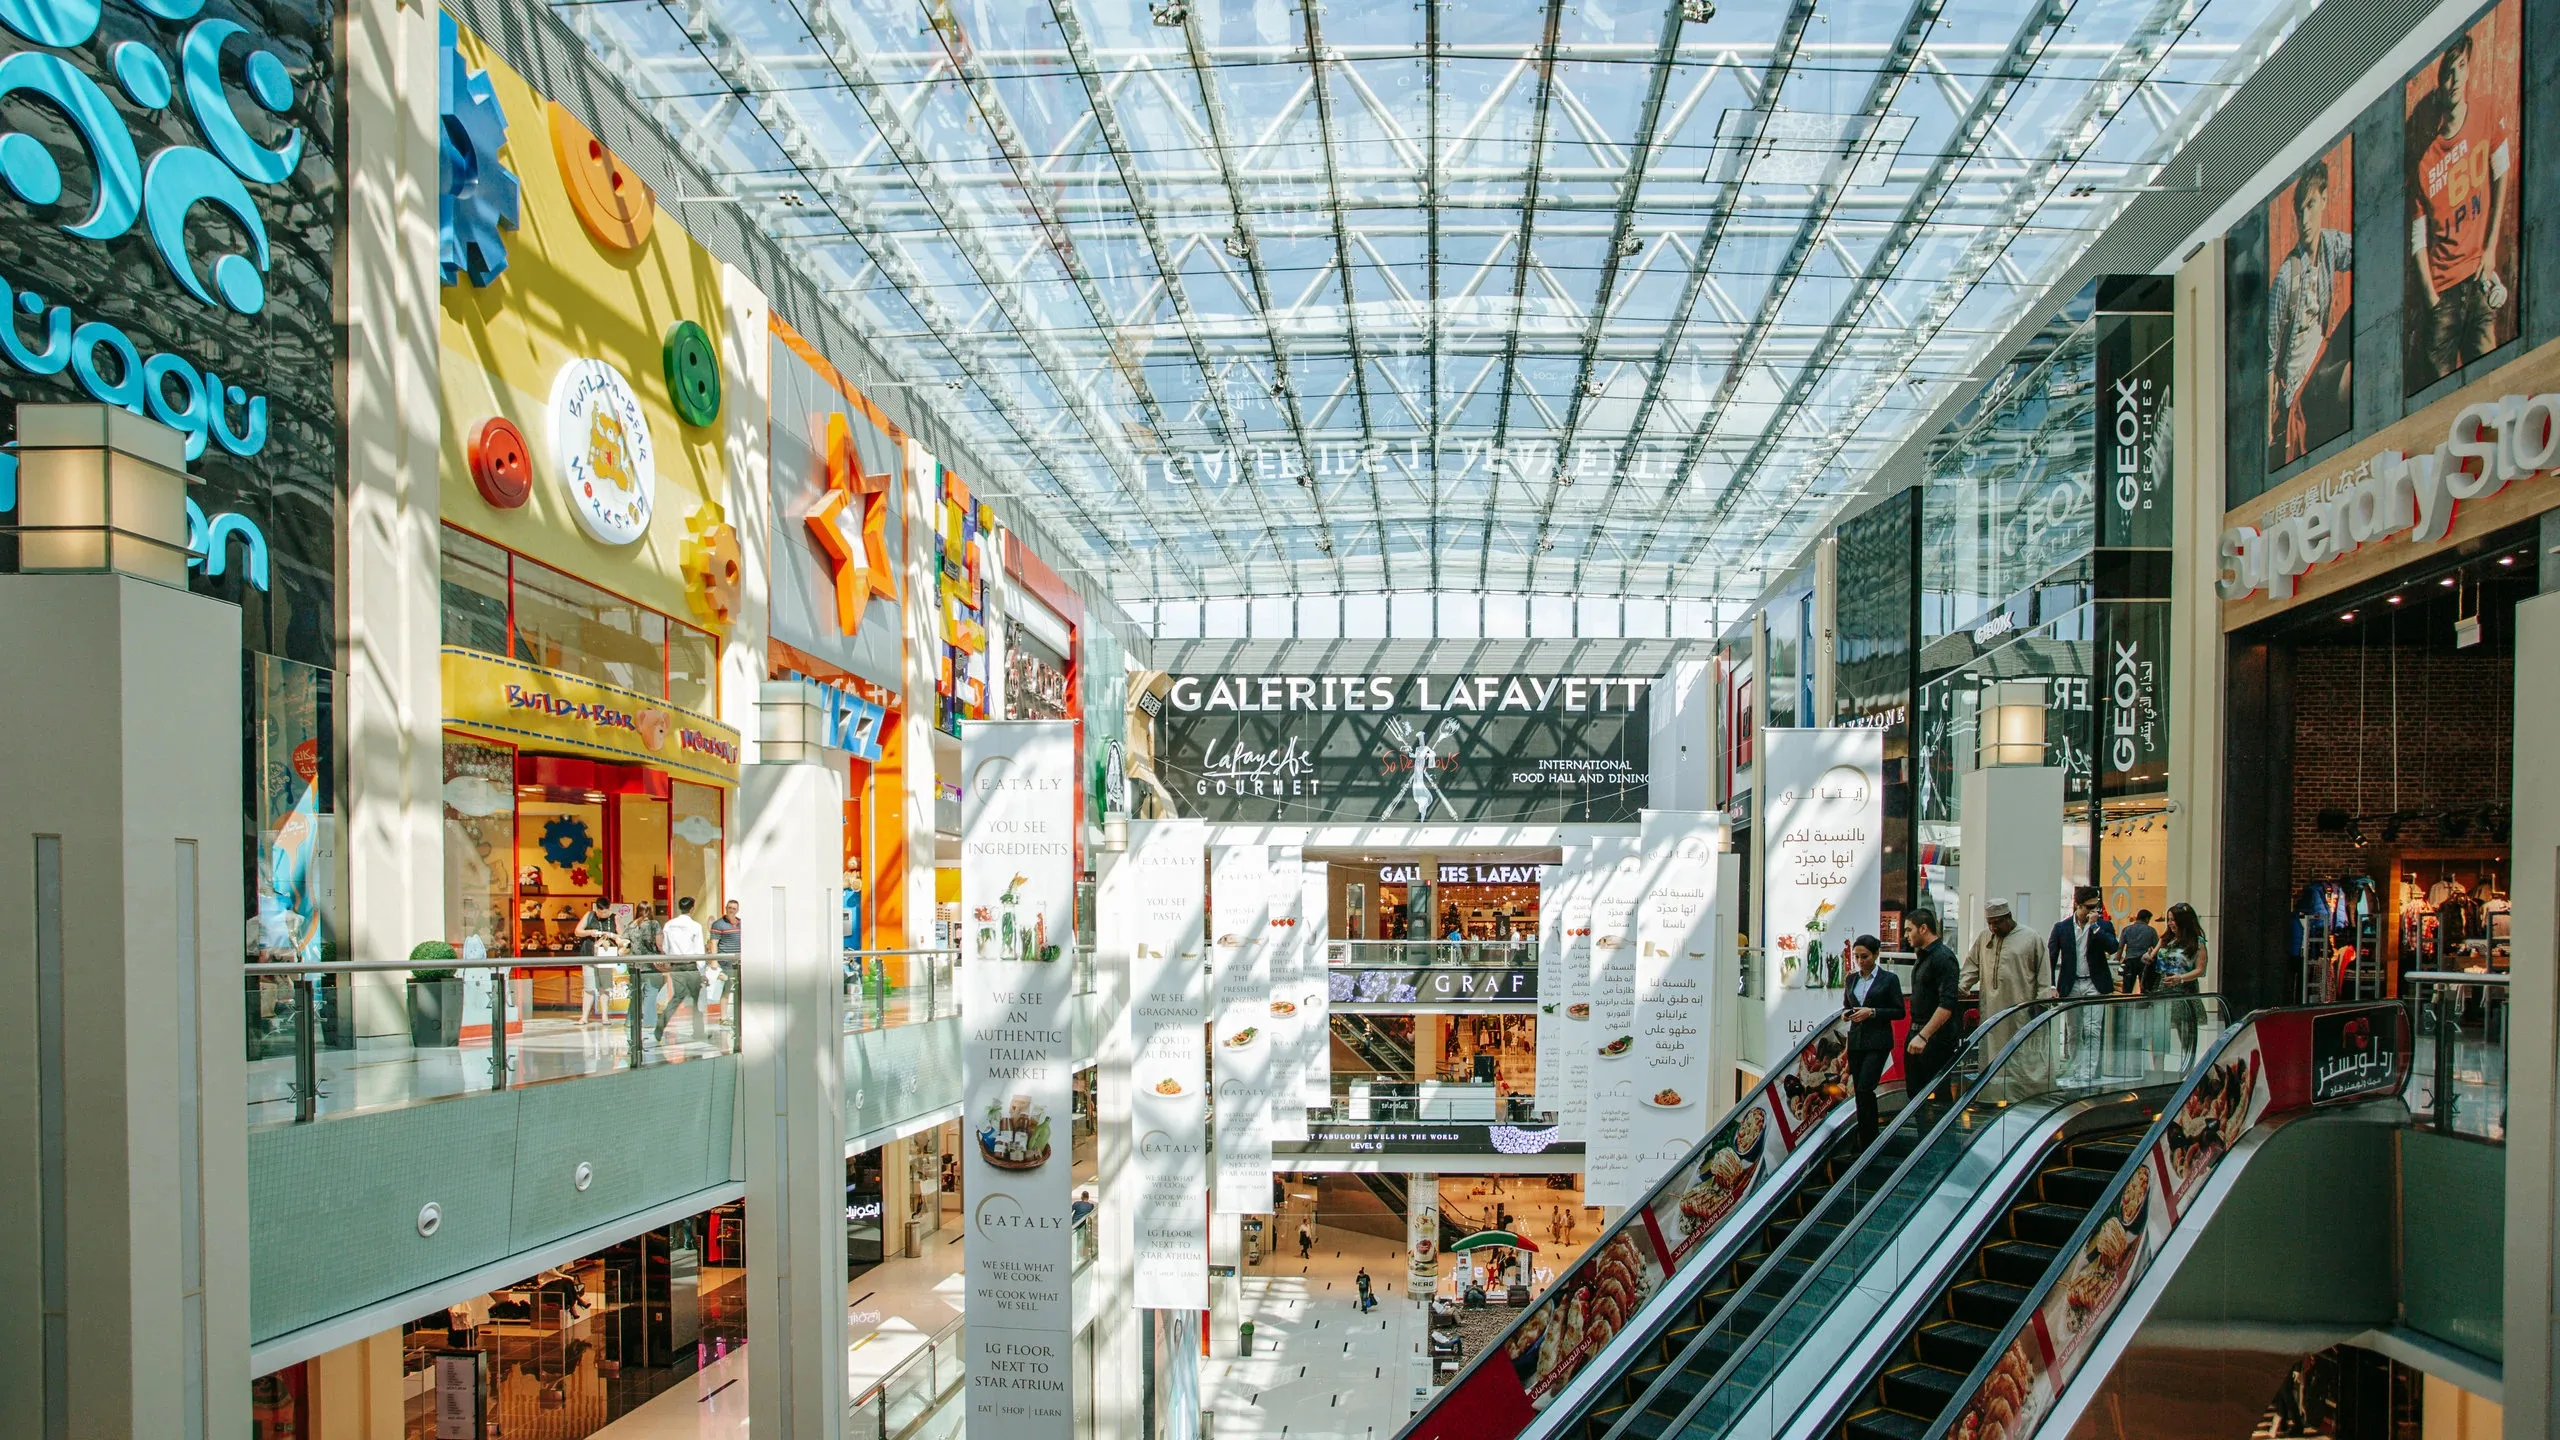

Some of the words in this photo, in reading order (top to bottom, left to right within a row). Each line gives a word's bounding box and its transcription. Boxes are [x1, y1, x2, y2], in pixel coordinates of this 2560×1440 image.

[2428, 139, 2468, 185] SUPER
[2447, 139, 2490, 208] 60
[2116, 378, 2139, 511] GEOX
[2142, 378, 2152, 510] BREATHES
[2214, 444, 2457, 601] Superdry
[1974, 610, 2015, 644] GEOX
[1171, 676, 1395, 712] GALERIES
[1416, 676, 1662, 712] LAFAYETT
[2113, 640, 2137, 772] GEOX
[1202, 736, 1314, 781] Lafayette
[1538, 759, 1633, 771] INTERNATIONAL
[980, 778, 1062, 790] EATALY
[1512, 773, 1545, 784] FOOD
[1549, 773, 1576, 784] HALL
[1578, 773, 1605, 784] AND
[1197, 779, 1319, 795] GOURMET
[988, 820, 1020, 833] YOU
[1023, 821, 1047, 833] SEE
[1782, 828, 1810, 847] لكم
[1814, 828, 1865, 846] بالنسبة
[968, 842, 1068, 856] INGREDIENTS
[1380, 865, 1469, 883] GALIES
[1795, 871, 1848, 889] مكونات
[1648, 887, 1668, 900] لكم
[1670, 887, 1704, 900] بالنسبة
[1147, 897, 1168, 907] YOU
[1169, 897, 1186, 907] SEE
[1153, 912, 1182, 921] PASTA
[1434, 975, 1540, 993] GRAF
[1650, 977, 1660, 987] لنا
[1662, 978, 1696, 990] بالنسبة
[992, 991, 1015, 1004] WE
[1020, 991, 1043, 1005] SEE
[1150, 993, 1167, 1002] WE
[1169, 993, 1185, 1003] SEE
[1007, 1011, 1027, 1024] AN
[1138, 1007, 1198, 1017] GRAGNANO
[1154, 1021, 1182, 1031] PASTA
[975, 1029, 1062, 1044] AUTHENTIC
[1146, 1036, 1190, 1045] COOKED
[1655, 1040, 1685, 1052] طريقة
[989, 1048, 1046, 1062] ITALIAN
[2317, 1036, 2379, 1097] لوبستر
[988, 1067, 1048, 1081] MARKET
[1146, 1143, 1200, 1153] EATALY
[984, 1214, 1063, 1229] EATALY
[1147, 1229, 1159, 1237] LG
[1151, 1240, 1174, 1249] NEXT
[1179, 1240, 1191, 1249] TO
[1141, 1251, 1163, 1260] STAR
[1165, 1252, 1201, 1261] ATRIUM
[982, 1261, 999, 1270] WE
[1000, 1261, 1022, 1271] SELL
[1023, 1262, 1055, 1272] WHAT
[993, 1271, 1009, 1281] WE
[978, 1288, 994, 1298] WE
[995, 1289, 1028, 1299] COOK
[1029, 1291, 1059, 1301] WHAT
[997, 1300, 1013, 1309] WE
[985, 1342, 1002, 1354] LG
[1006, 1344, 1055, 1358] FLOOR,
[991, 1360, 1025, 1372] NEXT
[1030, 1362, 1049, 1374] TO
[975, 1375, 1008, 1389] STAR
[1010, 1377, 1064, 1391] ATRIUM
[978, 1405, 992, 1413] EAT
[1001, 1406, 1025, 1415] SHOP
[1034, 1408, 1062, 1417] LEARN
